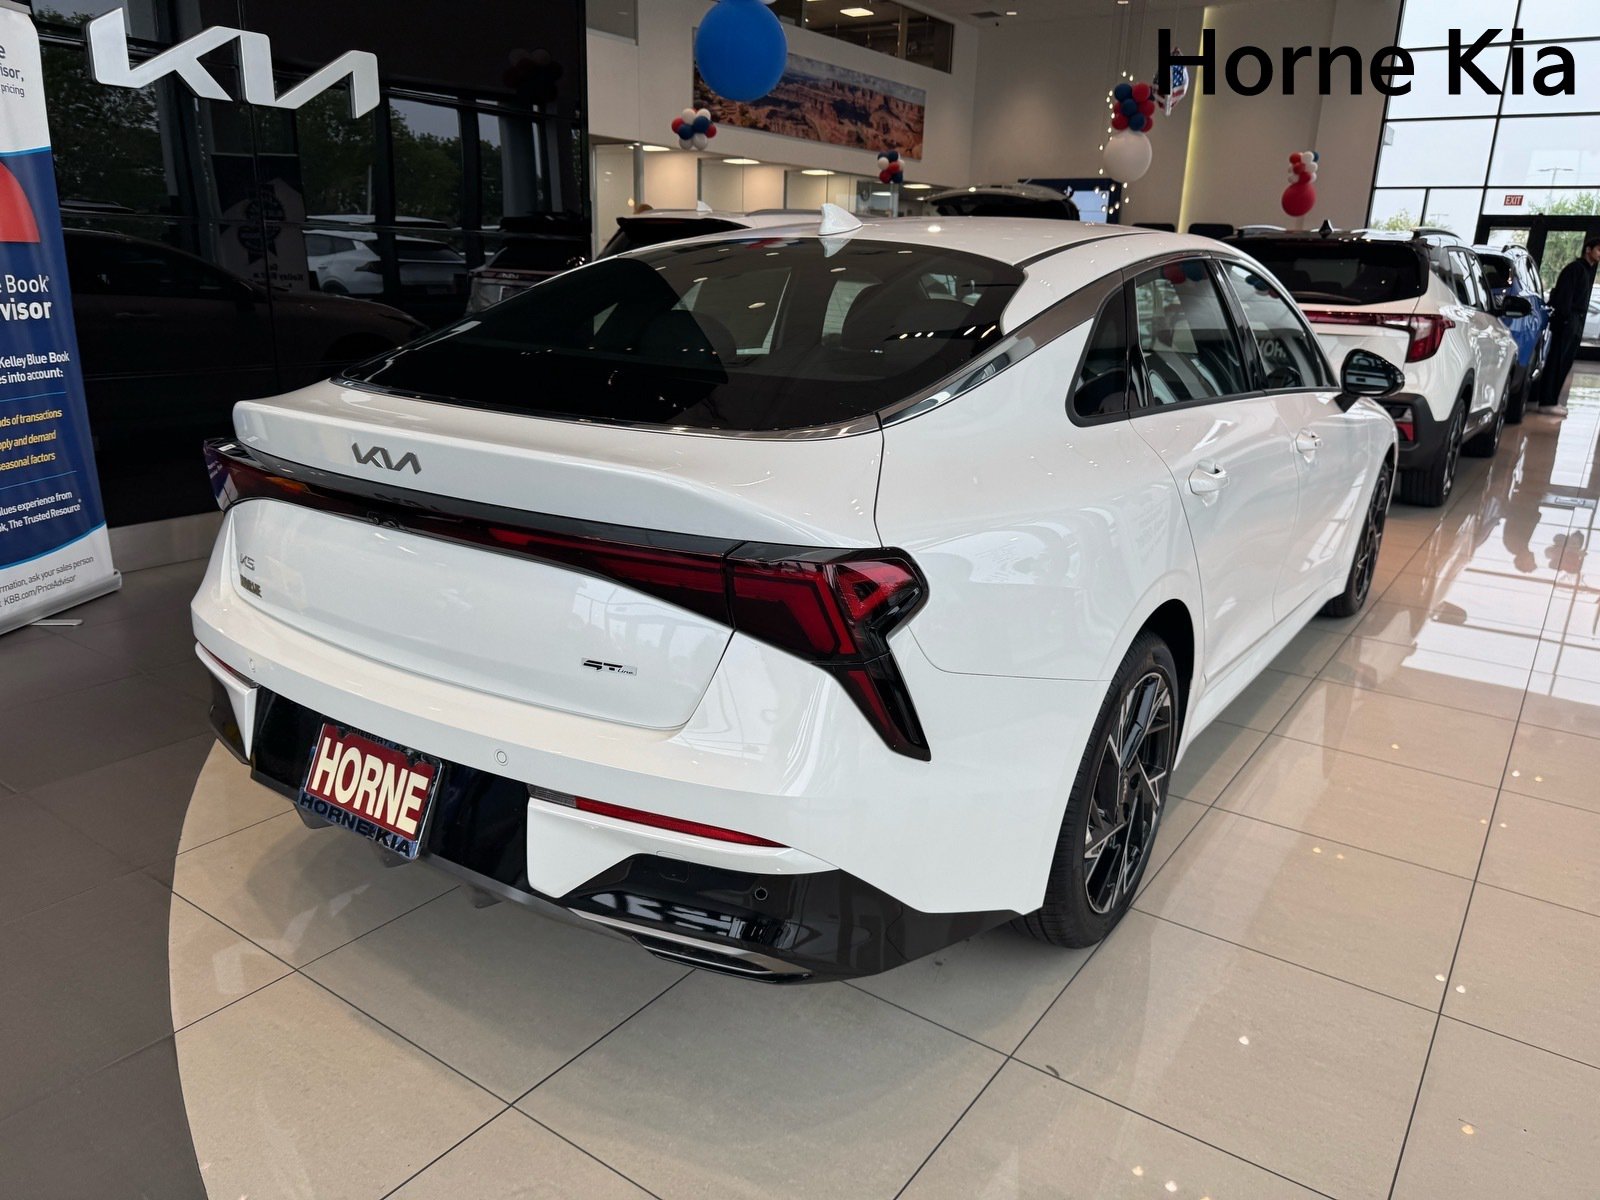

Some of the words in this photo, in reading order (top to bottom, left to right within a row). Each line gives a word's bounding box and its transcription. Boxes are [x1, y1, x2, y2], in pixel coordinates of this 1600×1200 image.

[86, 7, 380, 119] KIA
[1, 83, 25, 98] pricing
[1505, 196, 1522, 205] EXIT
[0, 297, 52, 321] visor
[0, 355, 26, 369] Kelley
[26, 353, 48, 366] Blue
[48, 350, 71, 364] Book
[7, 371, 27, 384] into
[26, 367, 64, 381] account:
[11, 414, 20, 426] of
[20, 409, 63, 424] transactions
[13, 434, 28, 447] and
[28, 429, 57, 444] demand
[30, 452, 56, 465] factors
[352, 442, 422, 475] KIA
[17, 495, 55, 511] experience
[55, 491, 73, 502] from
[8, 519, 23, 529] The
[22, 510, 50, 525] Trusted
[28, 573, 41, 584] ask
[41, 568, 55, 581] your
[56, 563, 73, 574] sales
[73, 556, 94, 570] person
[4, 574, 76, 606] KBB.com/PriceAdvisor
[311, 736, 429, 835] HORNE
[374, 824, 411, 857] KIA
